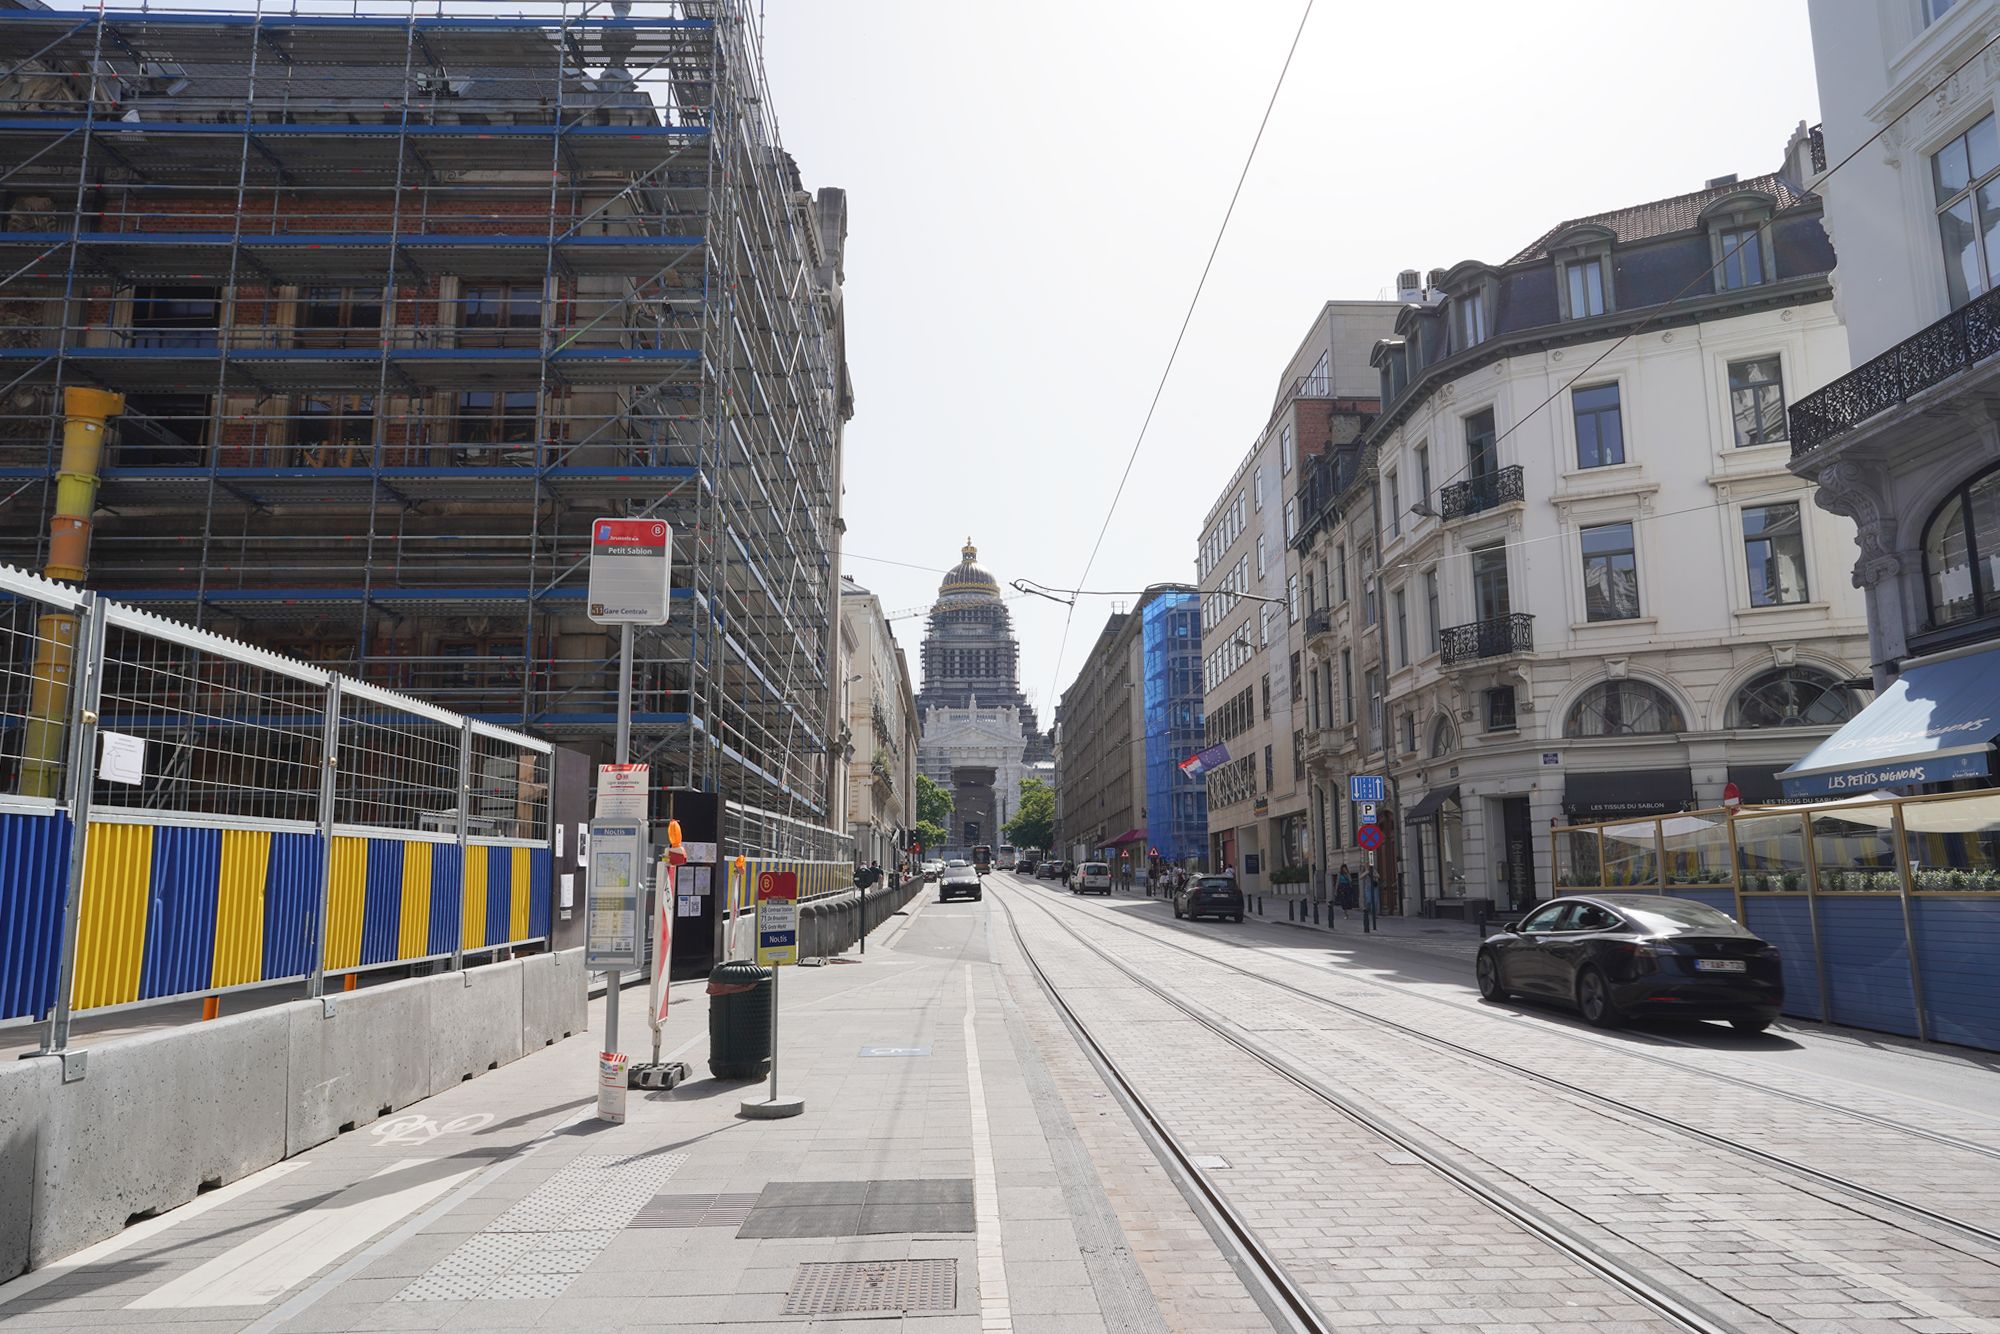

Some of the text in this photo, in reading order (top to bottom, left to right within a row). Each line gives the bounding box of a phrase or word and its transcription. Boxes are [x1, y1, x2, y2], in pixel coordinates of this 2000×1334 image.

[608, 547, 652, 555] Petit Sablon
[604, 606, 619, 615] Gare
[620, 606, 648, 615] Centrale
[1828, 776, 1846, 789] LES
[1847, 771, 1878, 787] PETITS
[1365, 805, 1372, 814] P
[764, 879, 770, 889] B
[769, 935, 788, 943] Noctis
